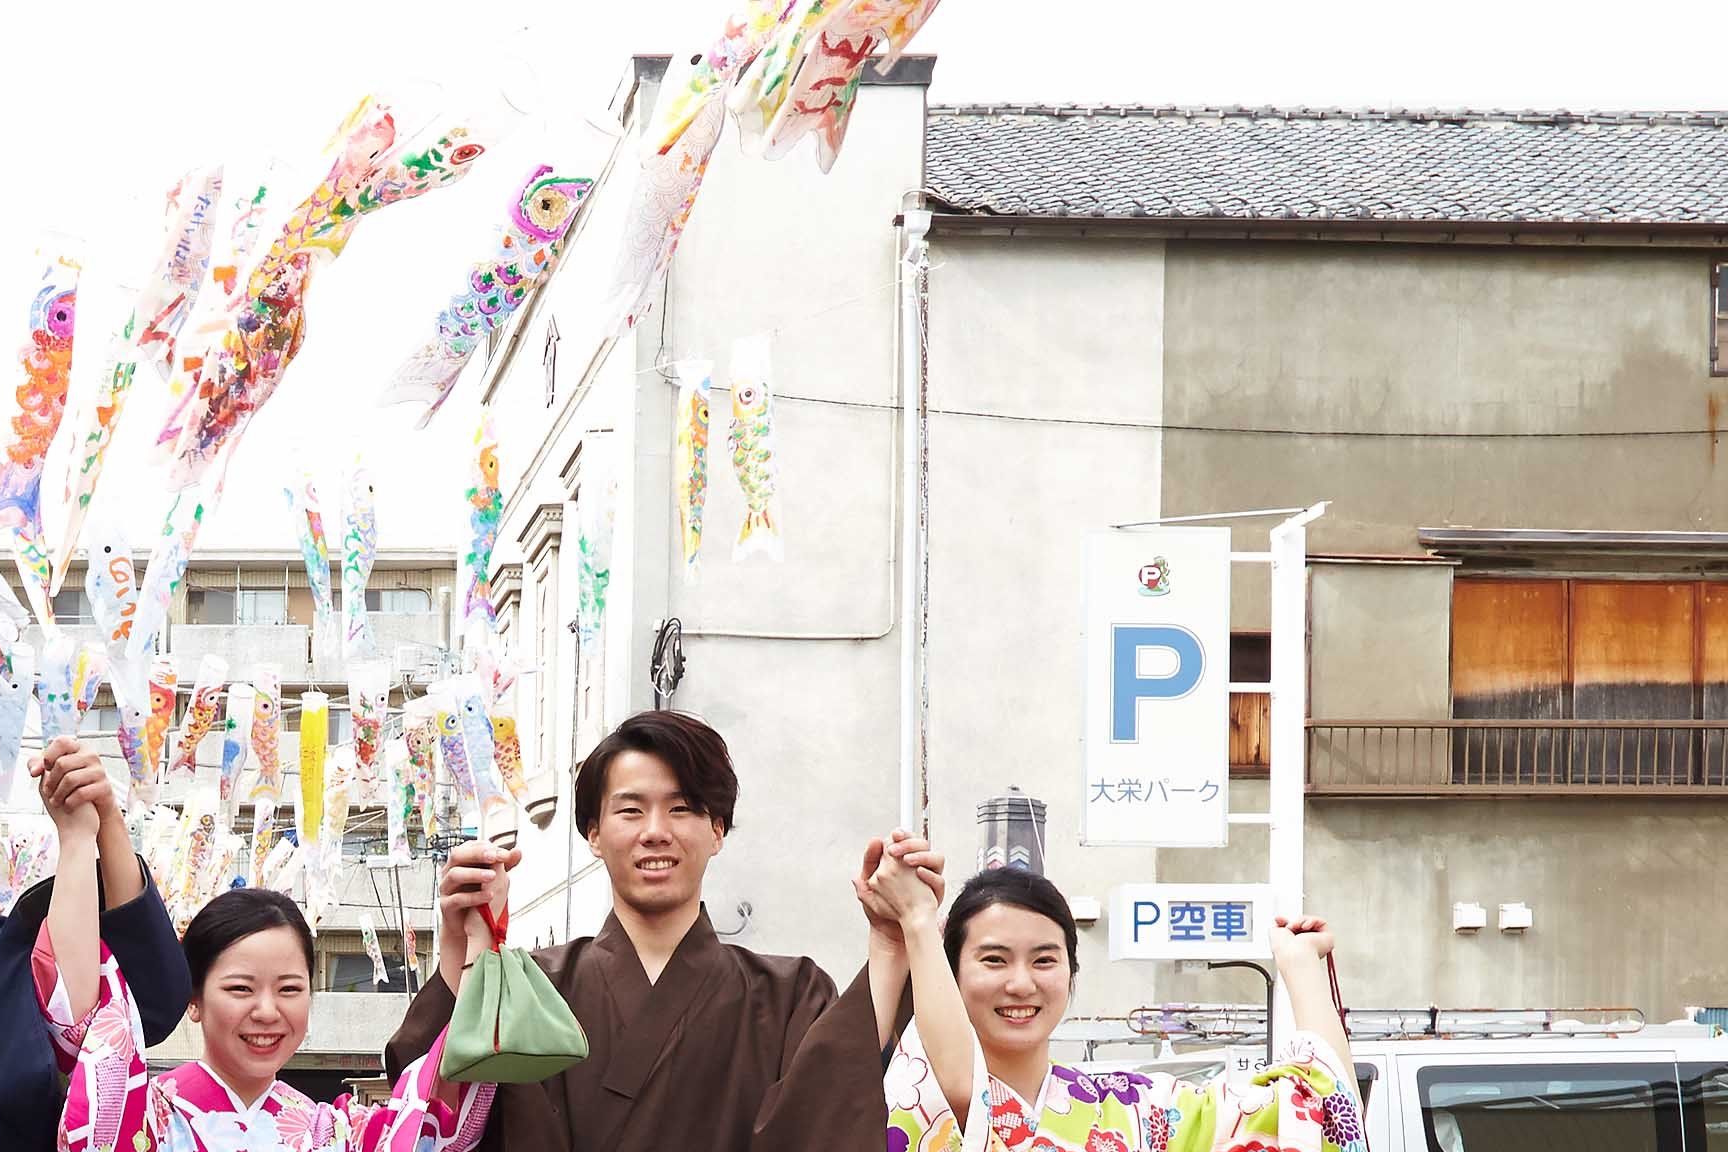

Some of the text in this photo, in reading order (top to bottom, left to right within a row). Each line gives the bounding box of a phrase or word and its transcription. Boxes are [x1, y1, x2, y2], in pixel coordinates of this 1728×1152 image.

[1110, 623, 1206, 744] P
[1090, 777, 1220, 803] 大栄パーク
[1134, 901, 1247, 942] P 空車
